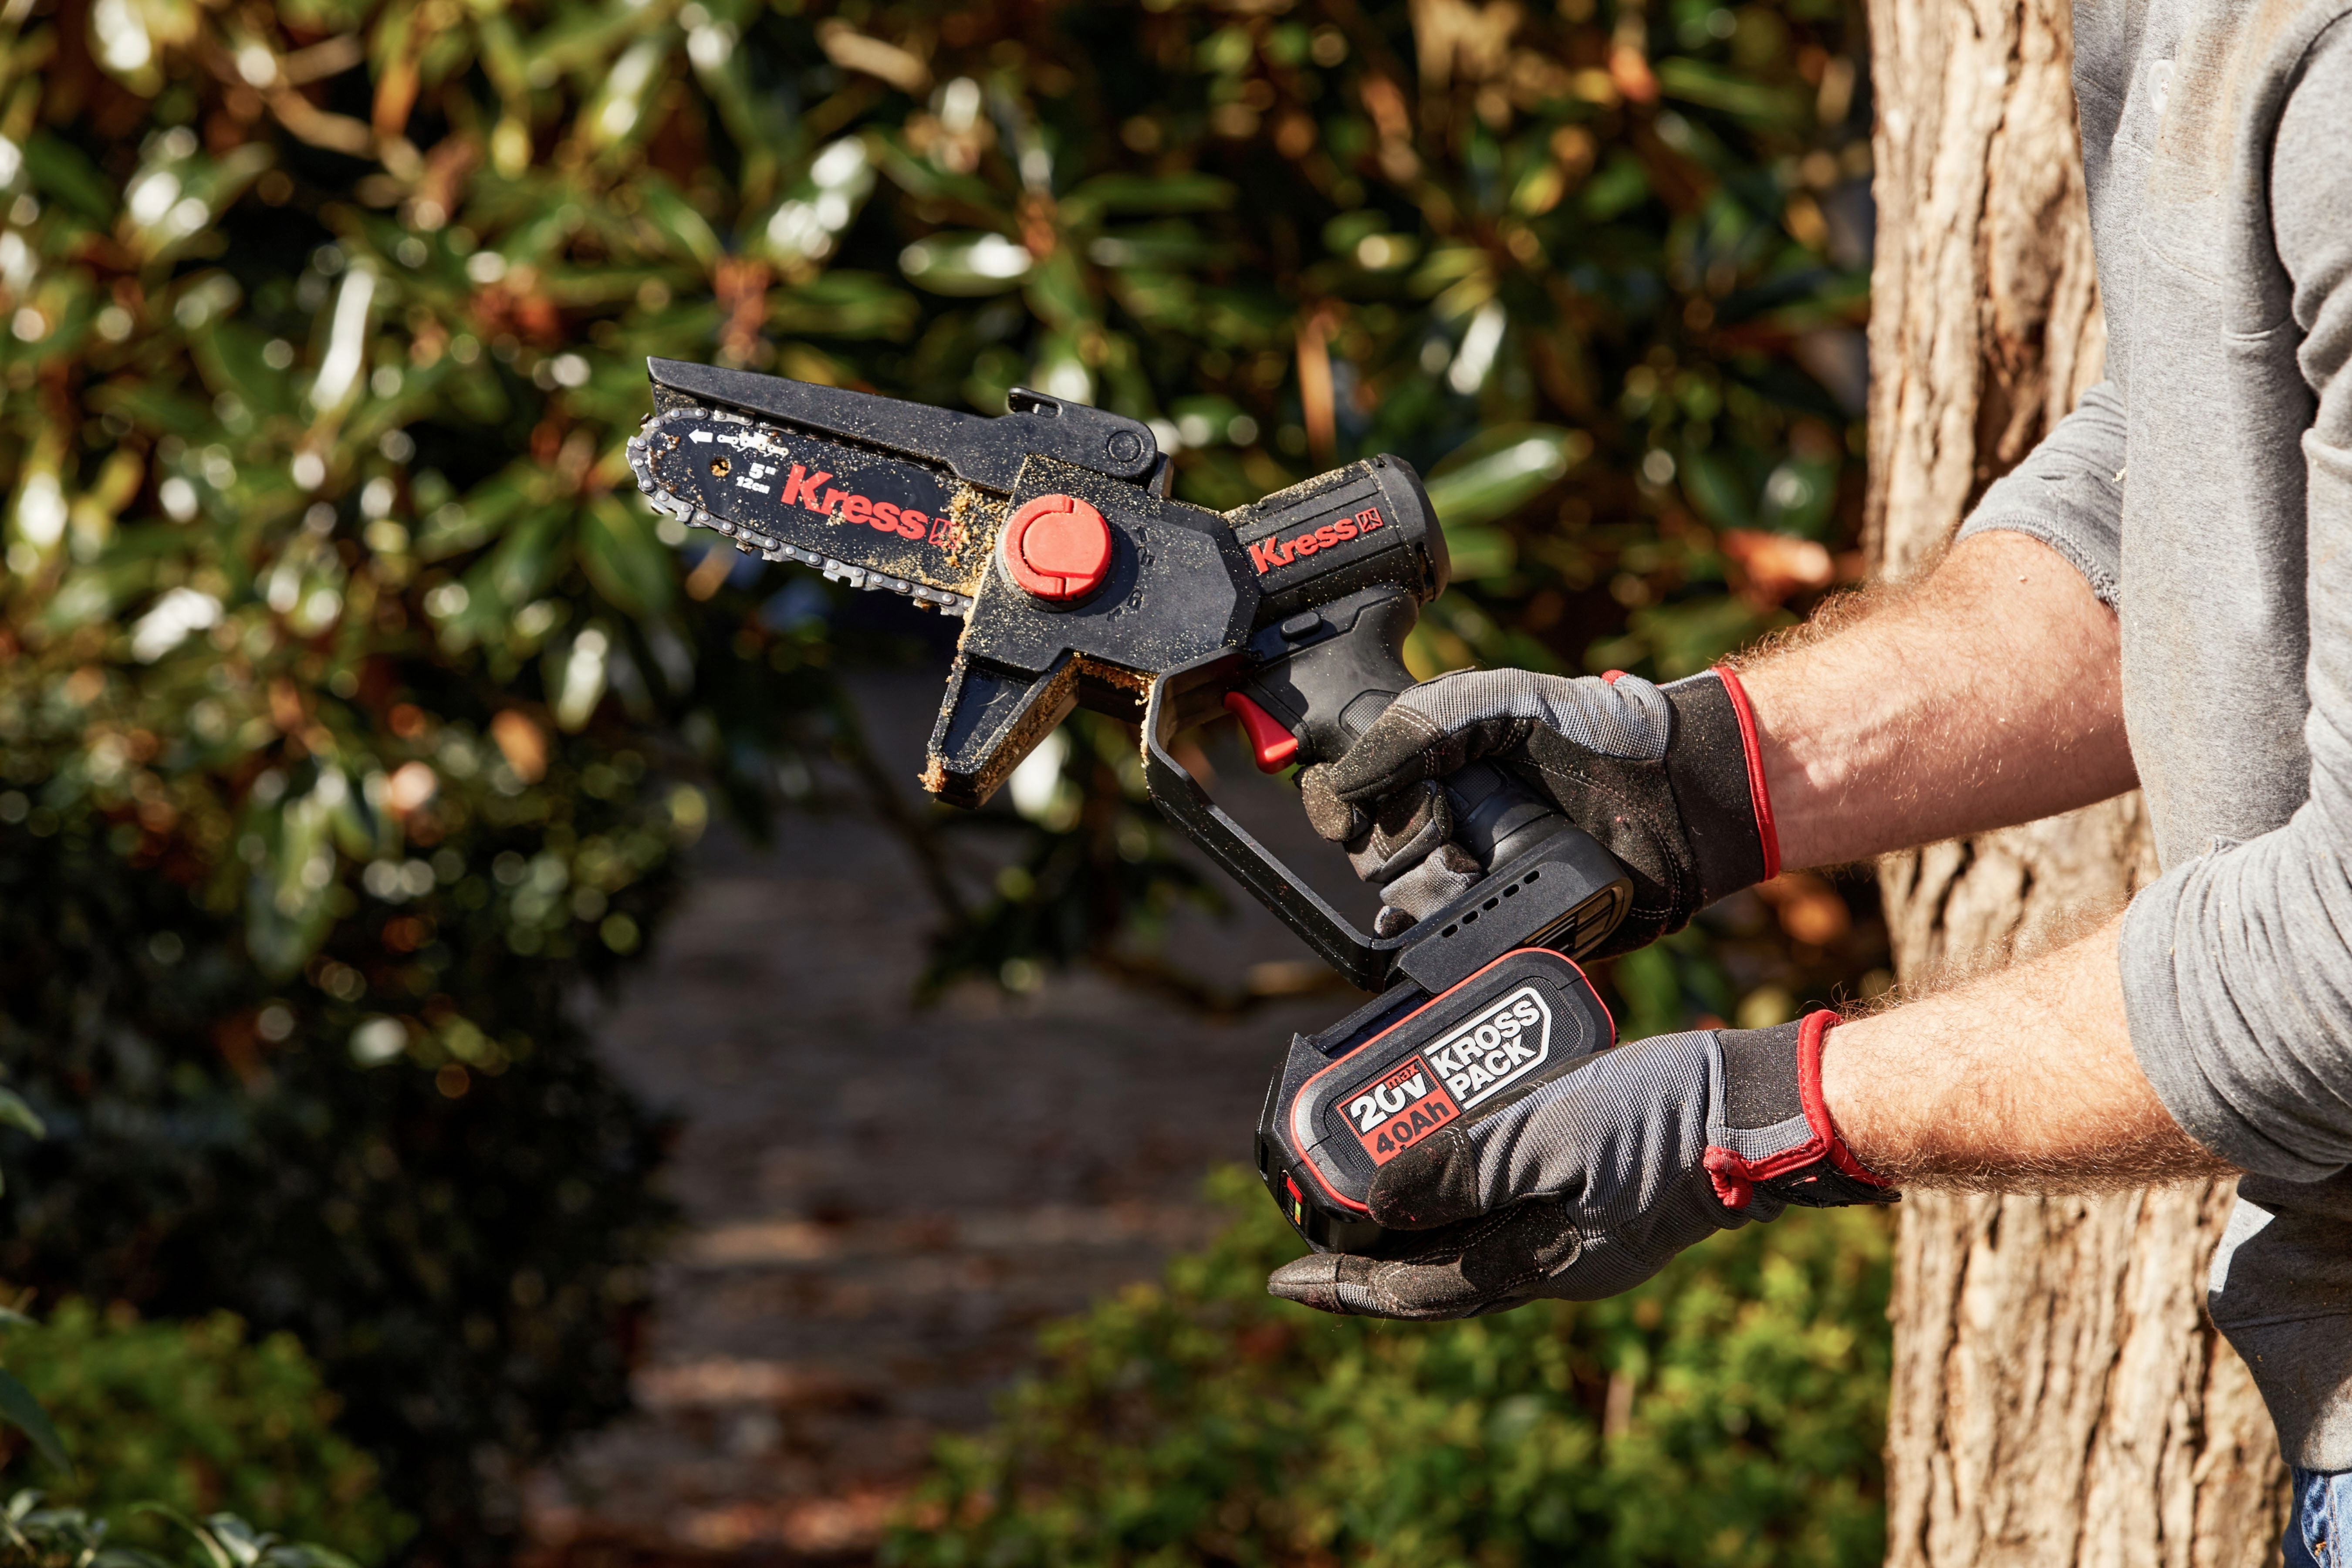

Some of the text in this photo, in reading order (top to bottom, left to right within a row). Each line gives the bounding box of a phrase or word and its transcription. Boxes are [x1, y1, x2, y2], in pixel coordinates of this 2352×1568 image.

[781, 464, 929, 540] Kress
[1248, 518, 1358, 574] Kress
[1429, 1000, 1540, 1080] KROSS
[1446, 1034, 1537, 1102] PACK
[1385, 1063, 1419, 1090] max
